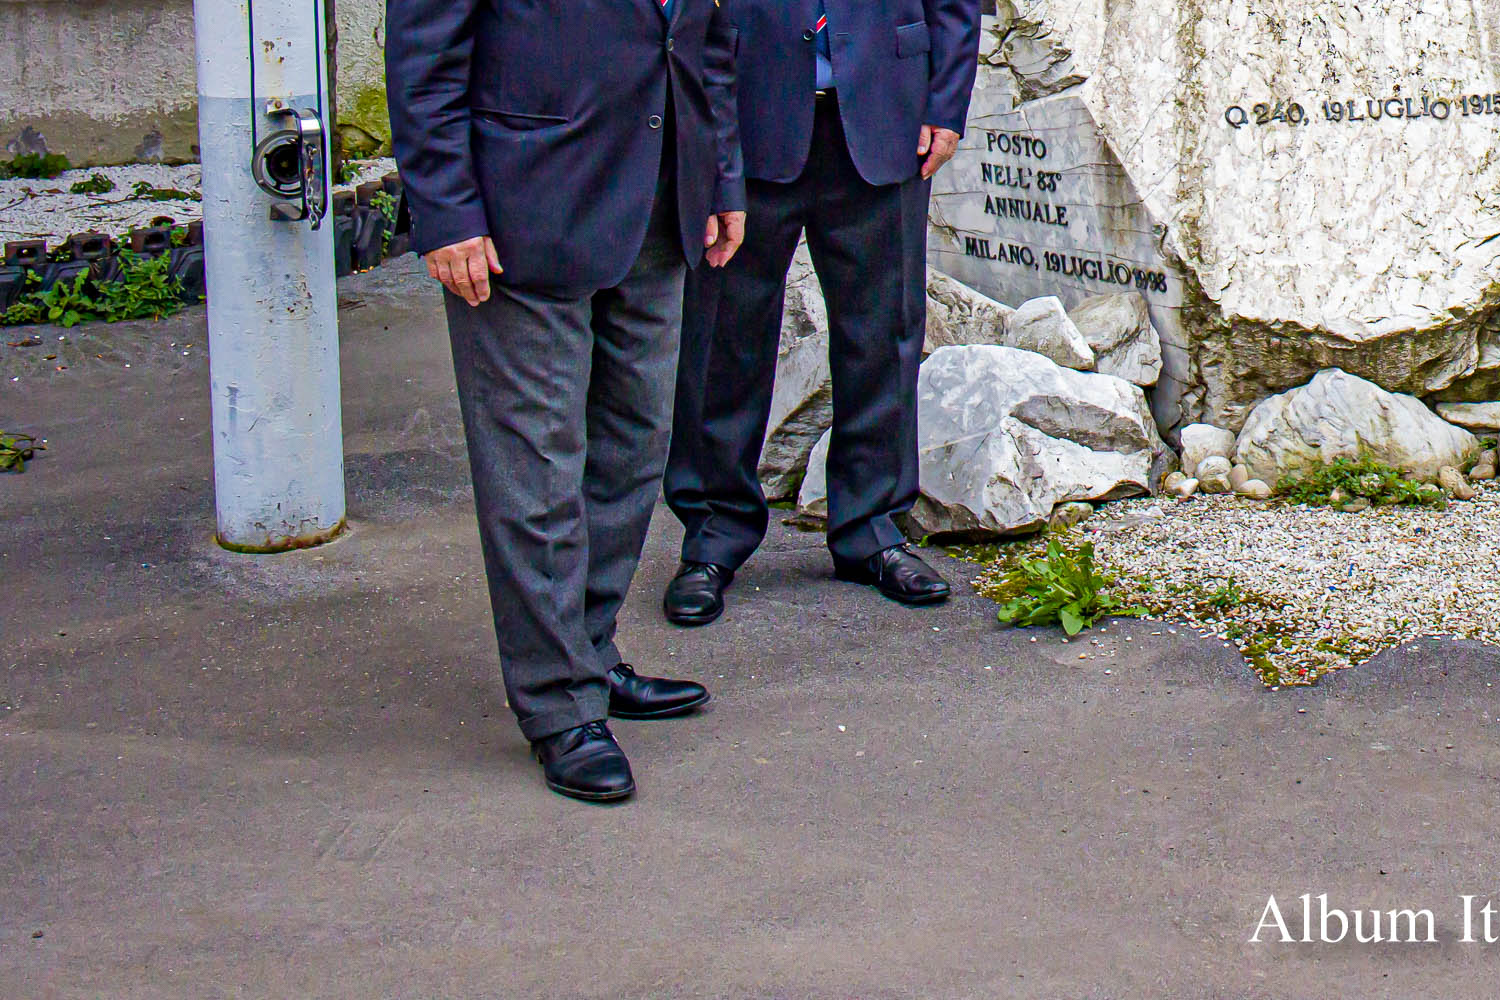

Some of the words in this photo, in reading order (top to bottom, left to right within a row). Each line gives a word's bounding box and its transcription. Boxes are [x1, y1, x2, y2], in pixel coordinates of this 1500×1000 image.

[1253, 101, 1310, 126] 240,
[986, 131, 1047, 159] POSTO
[980, 162, 1033, 189] NELL'
[1036, 171, 1062, 193] 83°
[984, 194, 1069, 227] ANNUALE
[964, 236, 1040, 271] MILANO,
